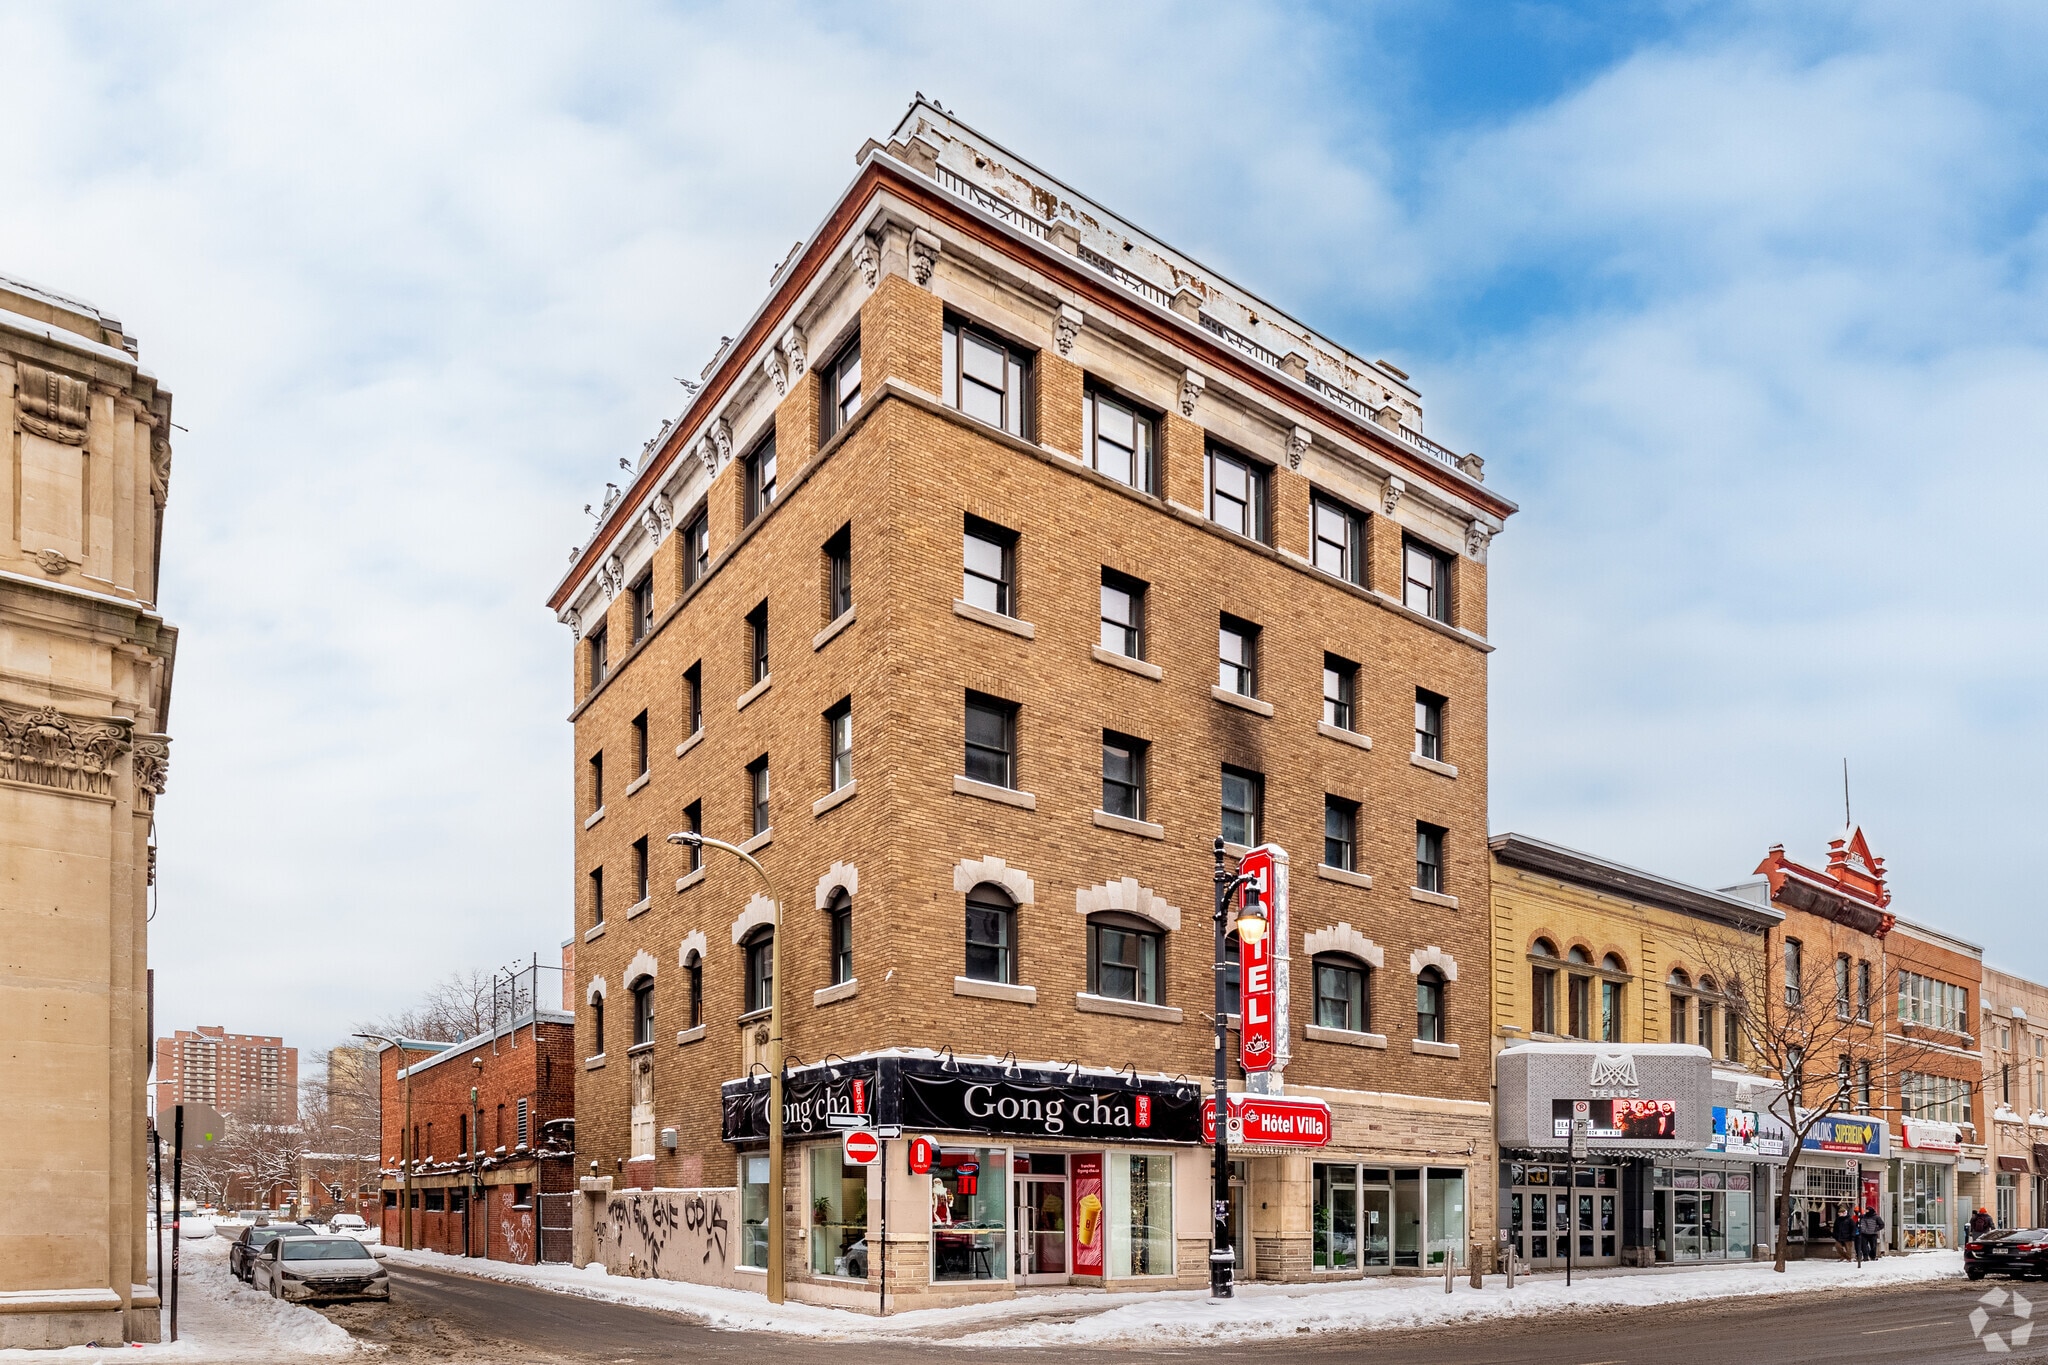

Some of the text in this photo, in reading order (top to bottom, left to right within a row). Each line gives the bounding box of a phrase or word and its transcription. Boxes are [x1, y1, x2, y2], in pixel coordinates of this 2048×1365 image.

[1247, 866, 1268, 1025] HTEL
[764, 1086, 851, 1133] ong cha
[963, 1085, 1132, 1133] Gong cha
[1590, 1088, 1640, 1099] TELUS
[1261, 1113, 1324, 1136] Hôtel Villa
